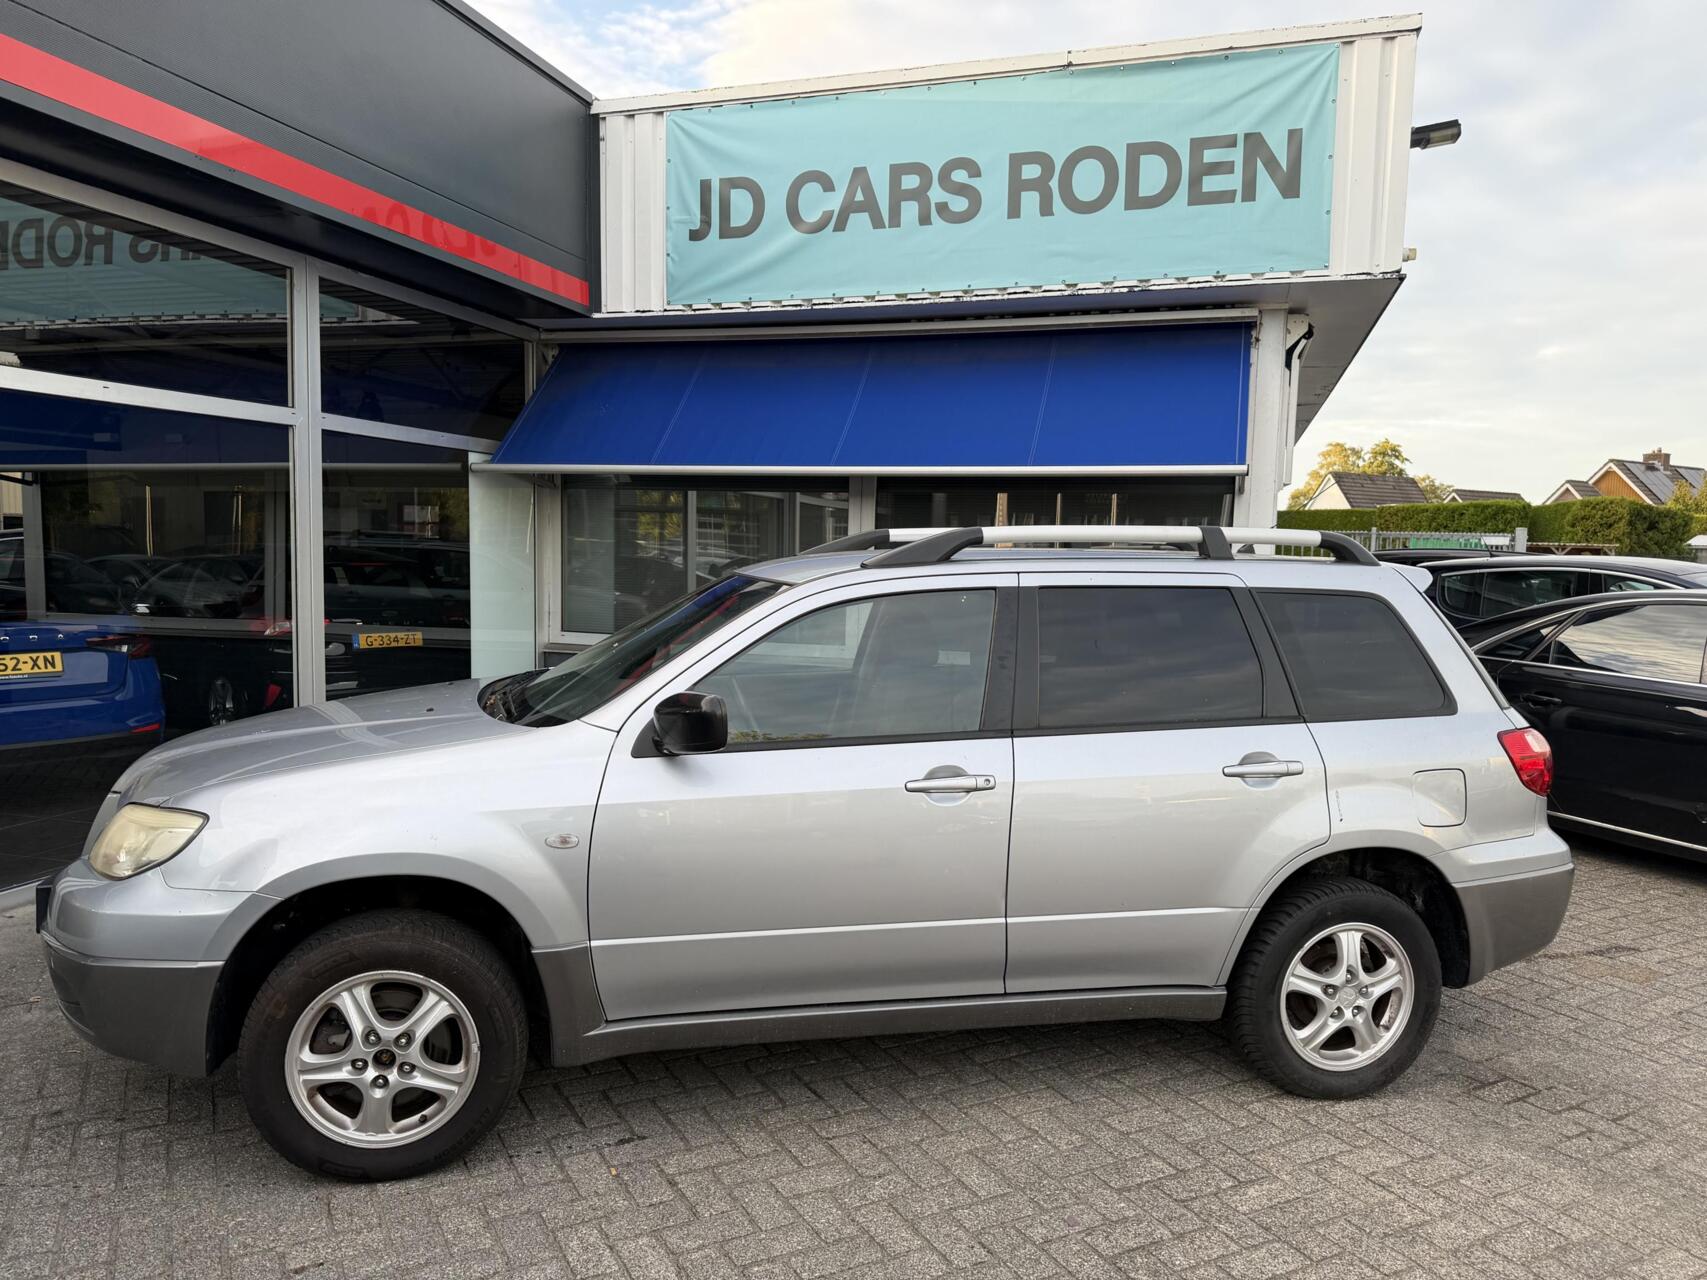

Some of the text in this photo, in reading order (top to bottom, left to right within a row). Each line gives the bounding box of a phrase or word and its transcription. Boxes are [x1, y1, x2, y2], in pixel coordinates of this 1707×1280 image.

[689, 128, 1303, 241] JD CARS RODEN
